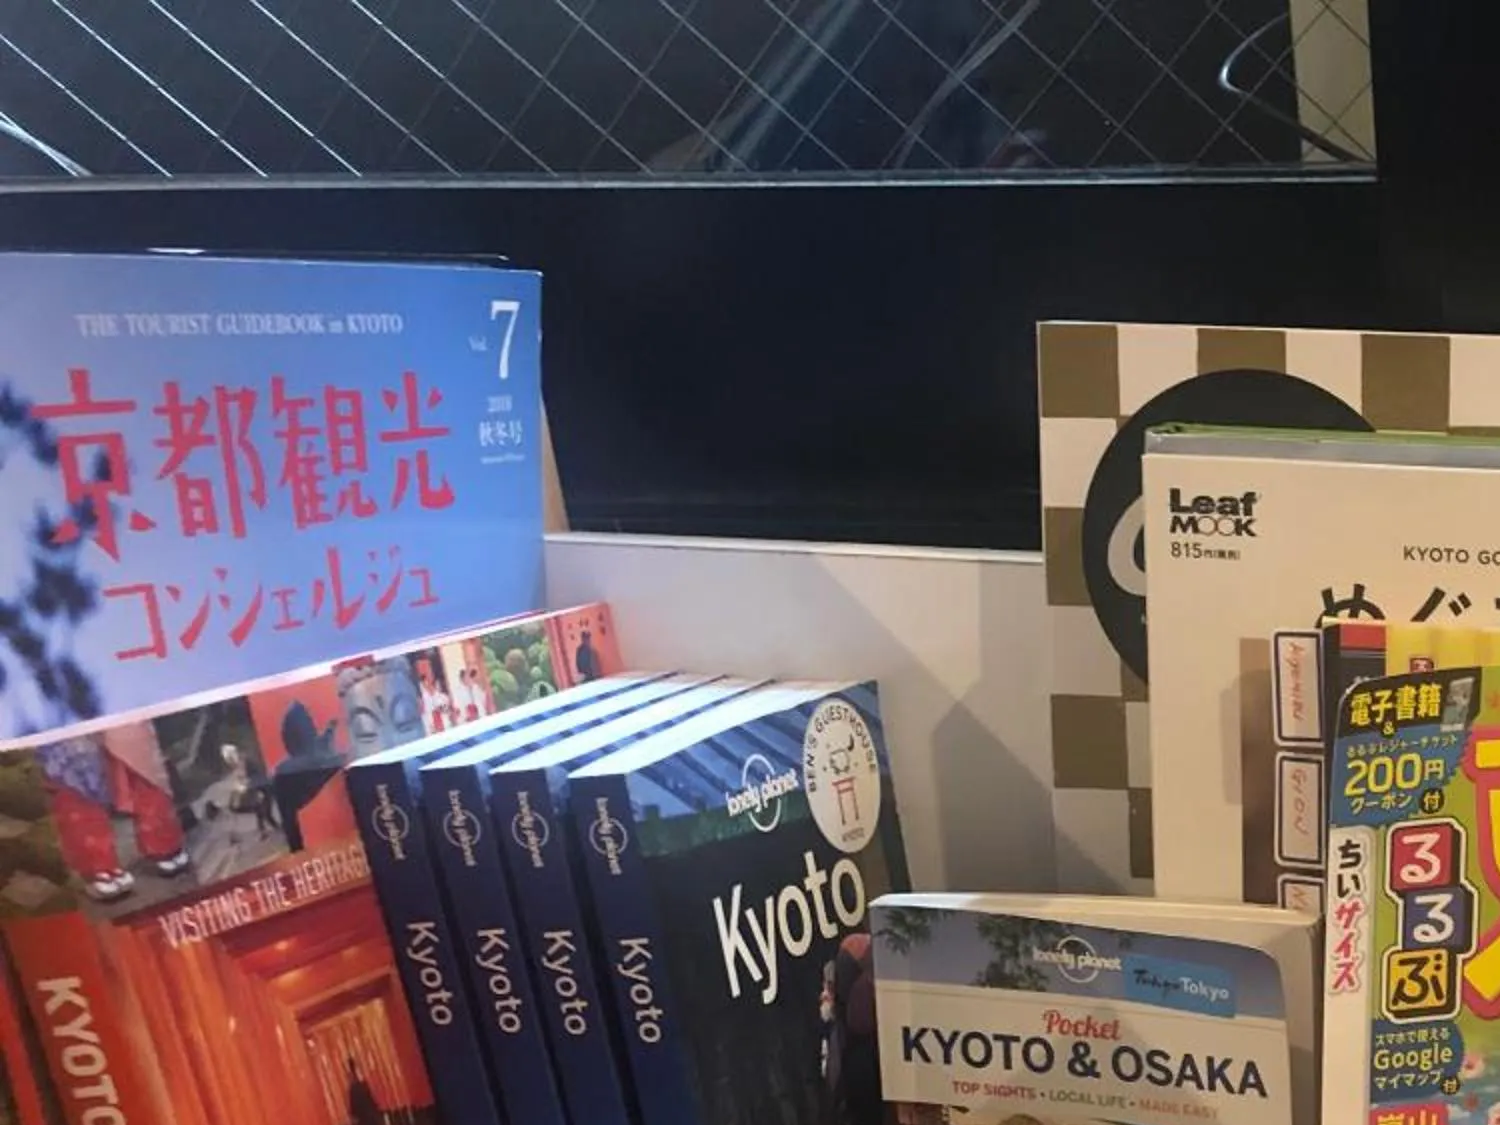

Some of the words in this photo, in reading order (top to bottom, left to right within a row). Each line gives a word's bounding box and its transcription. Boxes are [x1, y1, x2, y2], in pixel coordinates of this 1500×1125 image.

[75, 313, 123, 337] THE
[127, 313, 210, 336] TOURIST
[216, 314, 326, 335] GUIDEBOOK
[347, 314, 403, 334] KYOTO
[490, 300, 521, 380] 7
[28, 368, 456, 564] 京都観光
[1168, 514, 1257, 537] MOOK
[1169, 487, 1258, 516] Leaf
[1403, 545, 1470, 565] KYOTO
[102, 546, 440, 661] コンシェルジュ
[1350, 682, 1443, 726] 電子書籍
[726, 780, 762, 818] lonely
[758, 767, 800, 808] planet
[1344, 752, 1445, 797] 200円
[1350, 792, 1413, 815] クーポン
[161, 887, 252, 949] VISITING
[252, 870, 294, 912] THE
[292, 842, 372, 900] HERITAG
[1332, 839, 1364, 990] ちいサイズ
[1391, 832, 1456, 1007] るるぶ
[712, 851, 866, 1005] Kyoto
[406, 921, 453, 1026] Kyoto
[476, 928, 522, 1035] Kyoto
[543, 930, 588, 1037] Kyoto
[1032, 946, 1076, 971] lonely
[1077, 950, 1122, 973] planet
[618, 937, 663, 1044] Kyoto
[1179, 976, 1230, 1002] Tokyo
[1041, 1009, 1122, 1041] Pocket
[901, 1025, 1055, 1074] KYOTO
[1067, 1045, 1100, 1079] &
[1111, 1045, 1268, 1098] OSAKA
[1374, 1043, 1454, 1071] Google
[1375, 1070, 1443, 1090] マイマップ
[952, 1080, 981, 1097] TOP
[983, 1082, 1037, 1101] SIGHTS
[1048, 1088, 1094, 1105] LOCAL
